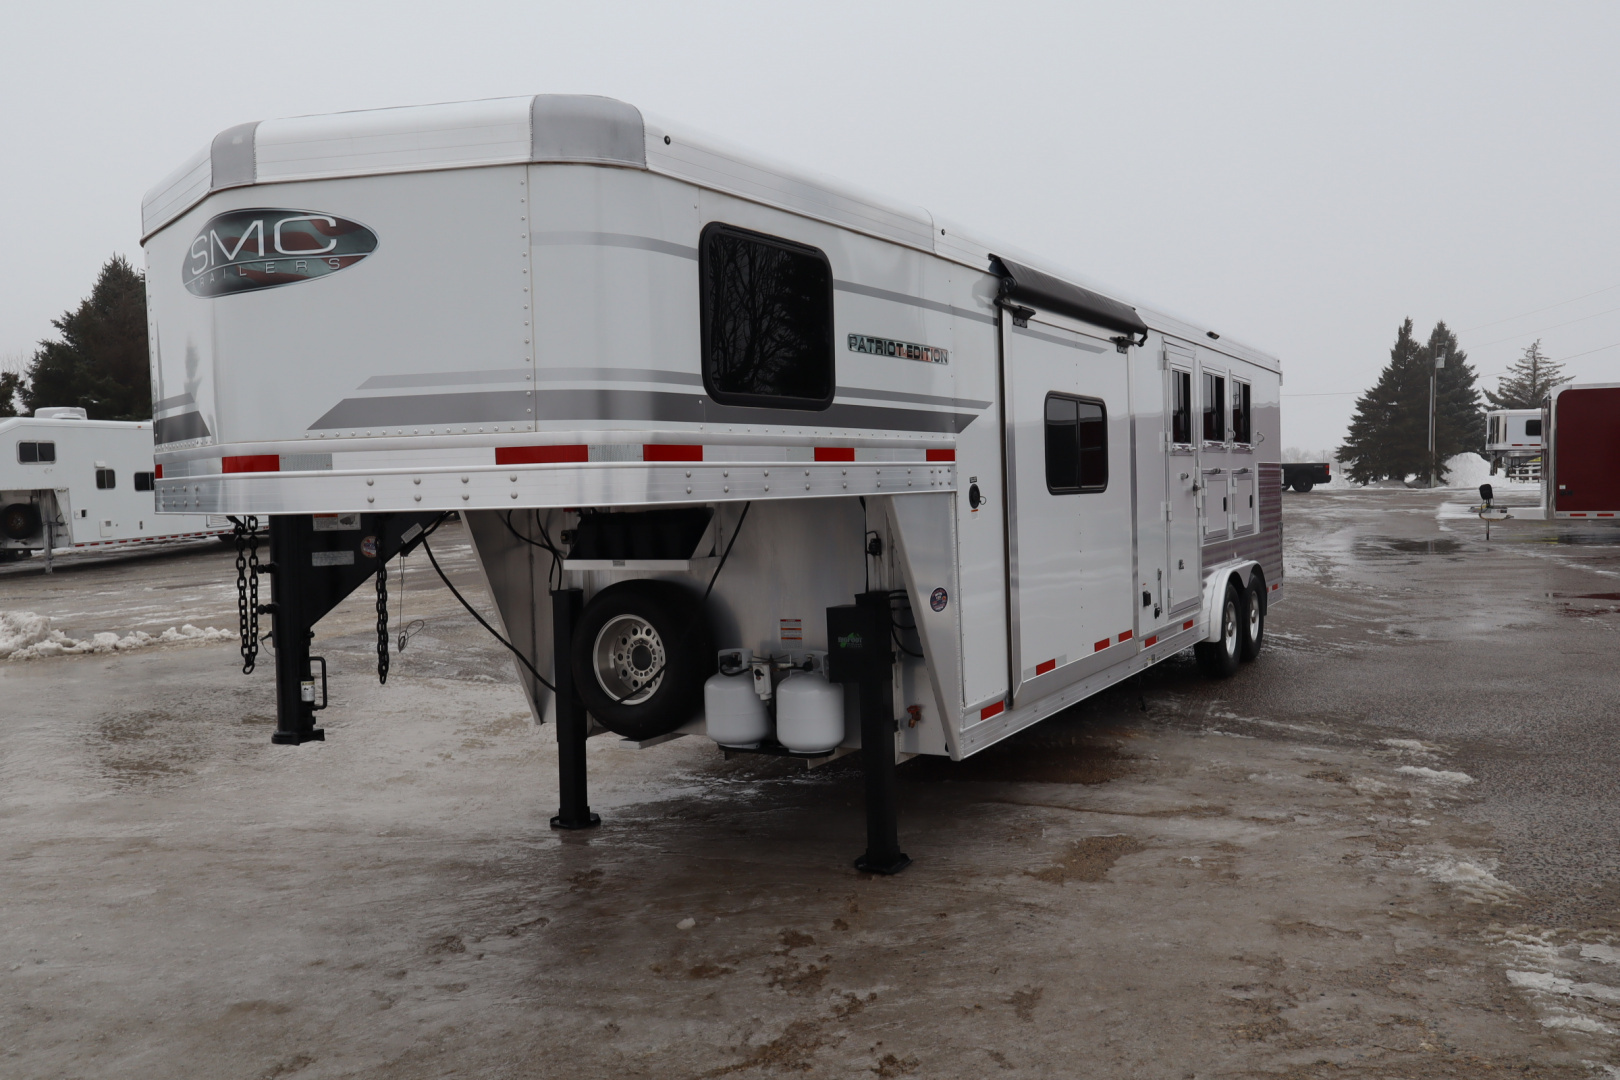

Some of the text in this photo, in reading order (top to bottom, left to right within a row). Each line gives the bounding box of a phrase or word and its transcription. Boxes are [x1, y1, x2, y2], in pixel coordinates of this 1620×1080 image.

[190, 214, 338, 275] SMC
[191, 258, 340, 288] TRAILERS
[849, 336, 948, 363] PATRIOT EDITION
